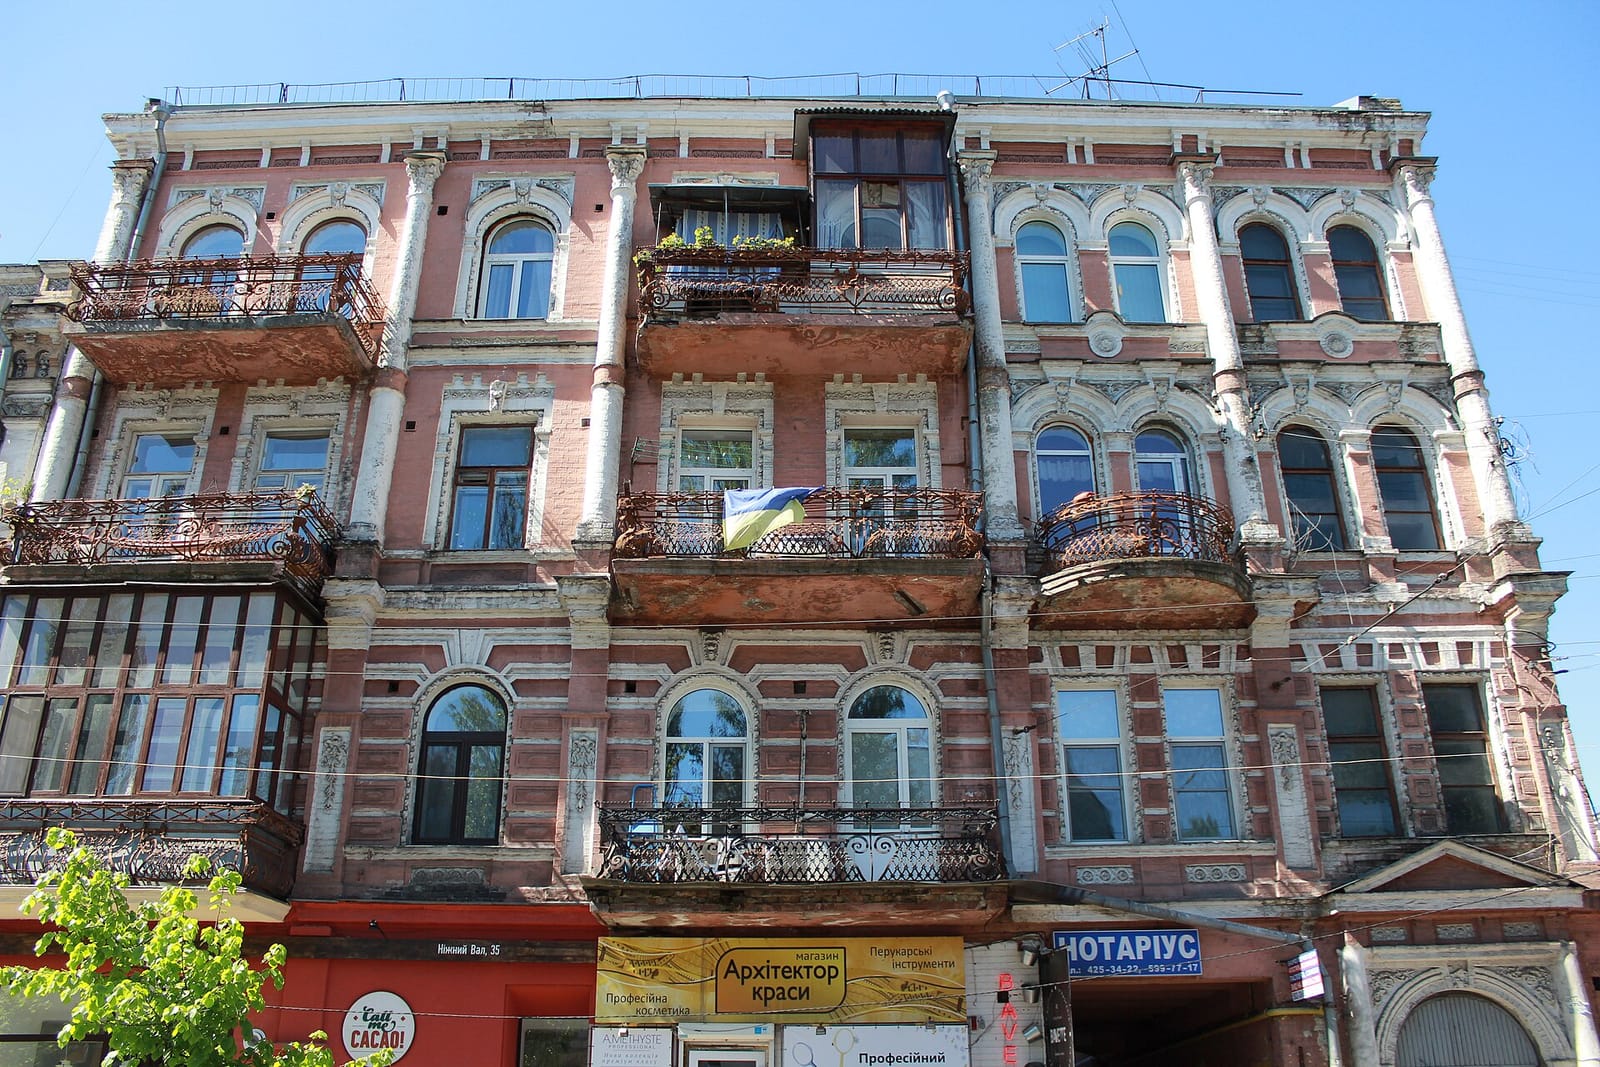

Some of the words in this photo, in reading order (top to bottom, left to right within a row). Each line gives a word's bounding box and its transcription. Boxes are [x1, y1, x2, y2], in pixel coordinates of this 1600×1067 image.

[437, 943, 468, 955] Ніжний
[470, 944, 488, 957] Вал,
[490, 944, 501, 956] 35
[870, 946, 932, 958] Перукарські
[1058, 934, 1197, 962] НОТАРІУС
[796, 952, 839, 961] магазин
[892, 959, 956, 970] інструменти
[723, 958, 839, 986] Архітектор
[606, 992, 668, 1005] Професійна
[752, 986, 810, 1007] краси
[362, 1006, 393, 1022] Call
[635, 1006, 691, 1015] косметика
[368, 1020, 396, 1032] me
[351, 1030, 405, 1049] CACAO!
[602, 1034, 662, 1044] AMETHYSTE
[859, 1053, 945, 1066] Професійний
